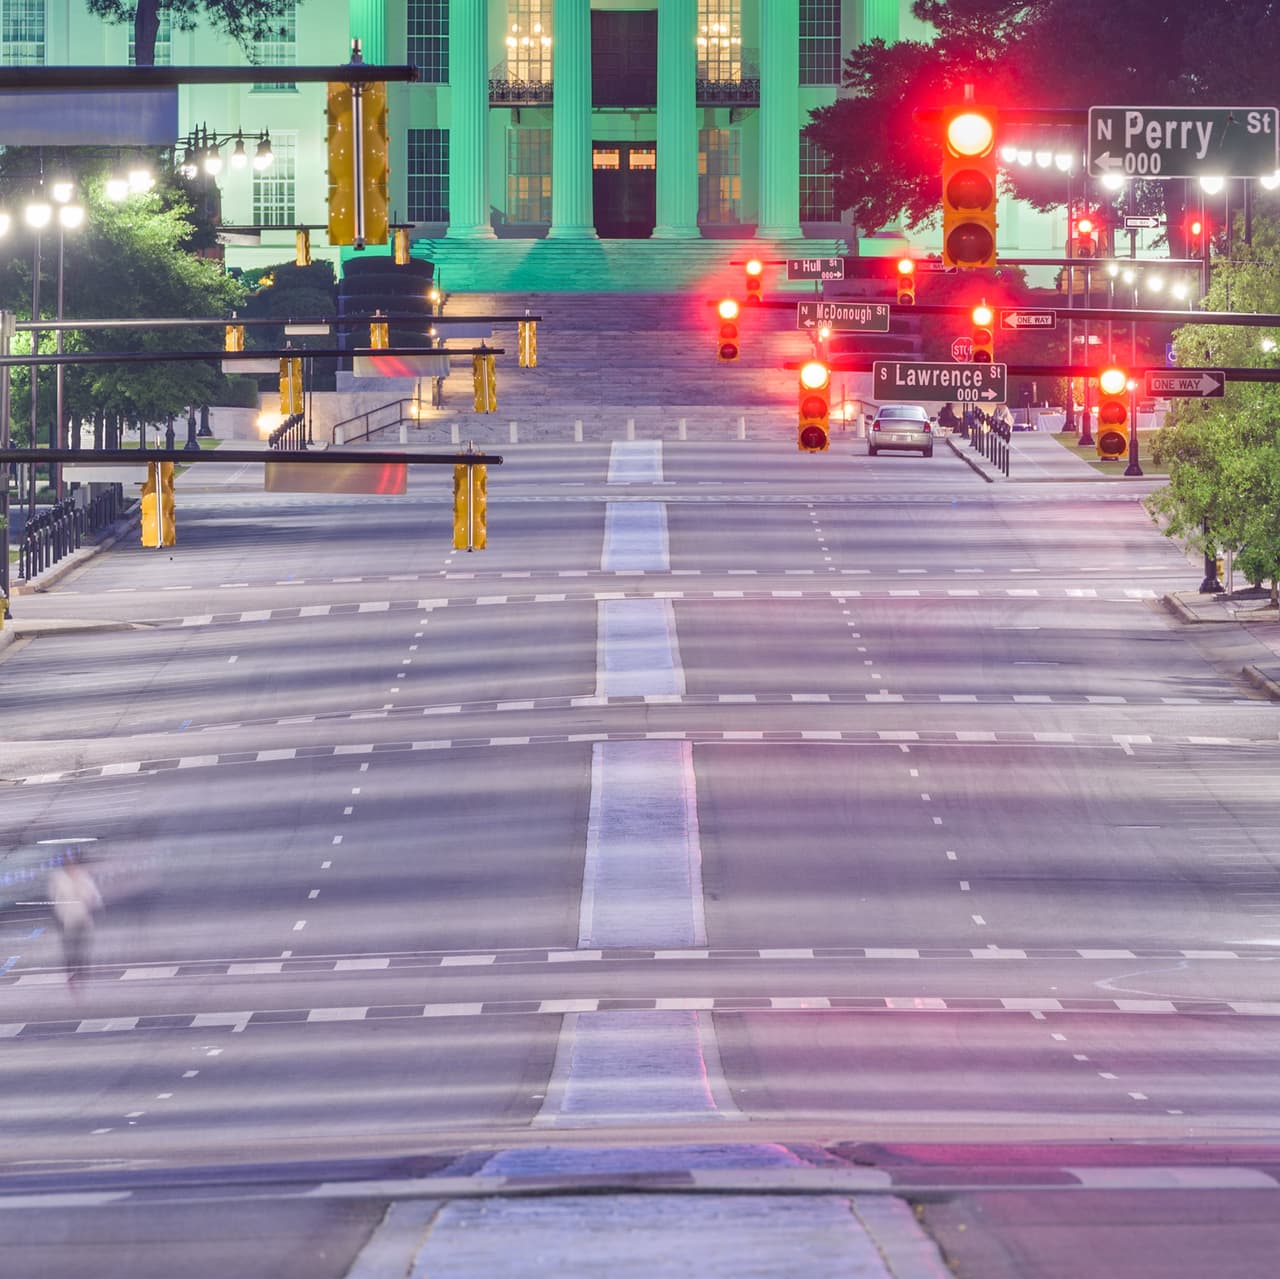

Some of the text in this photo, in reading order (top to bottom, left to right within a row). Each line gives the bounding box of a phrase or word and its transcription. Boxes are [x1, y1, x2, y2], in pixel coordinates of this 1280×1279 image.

[1097, 111, 1271, 160] N Perry St
[1125, 152, 1161, 174] 000
[803, 259, 821, 272] Hull
[829, 259, 837, 267] St
[801, 303, 886, 325] N McDonough St
[1017, 316, 1050, 324] ONE WAY
[818, 320, 832, 329] 000
[880, 363, 1001, 387] S Lawrence St
[1154, 380, 1201, 389] ONE WAY
[957, 388, 979, 401] 000
